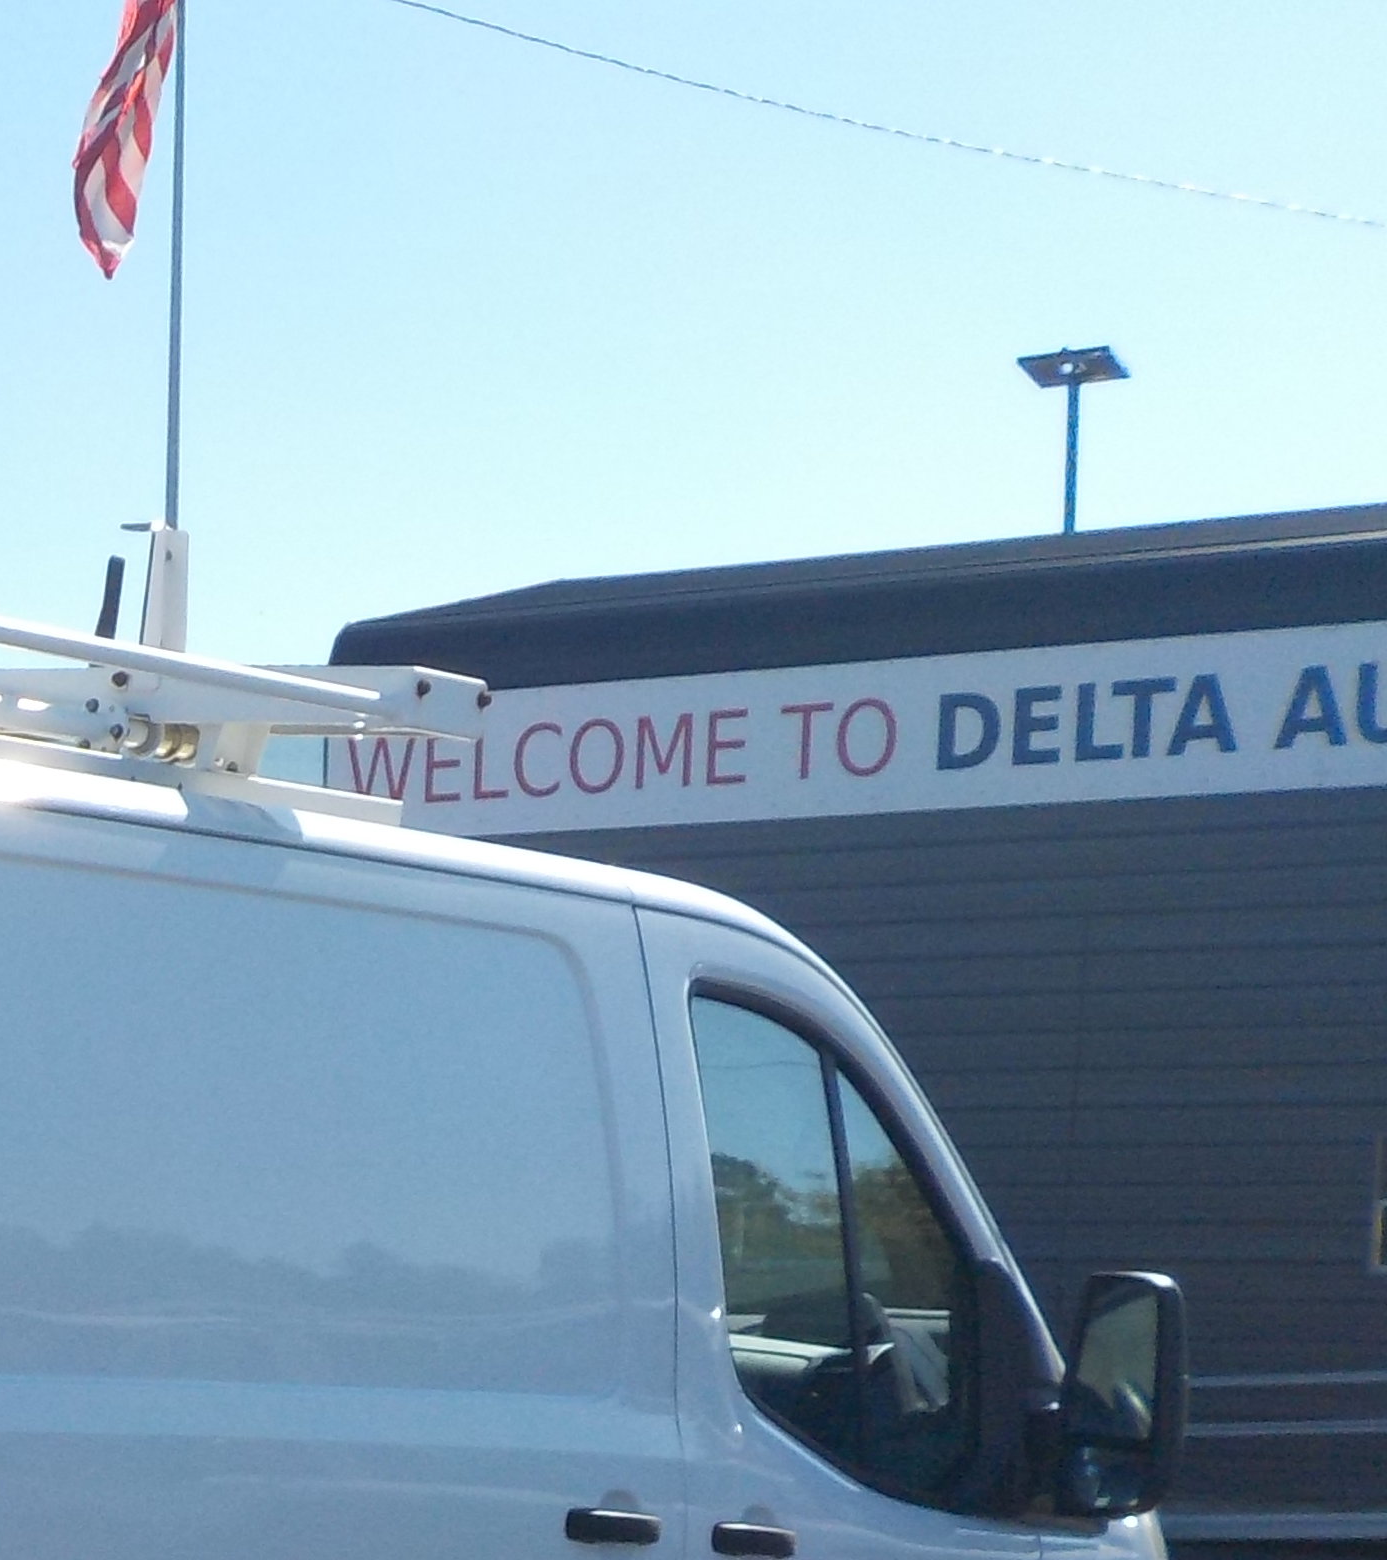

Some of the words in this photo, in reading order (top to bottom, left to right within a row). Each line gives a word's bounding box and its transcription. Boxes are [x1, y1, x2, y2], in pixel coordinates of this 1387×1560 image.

[347, 687, 749, 803] WELCOME
[780, 697, 898, 780] TO
[935, 672, 1238, 772] DELTA
